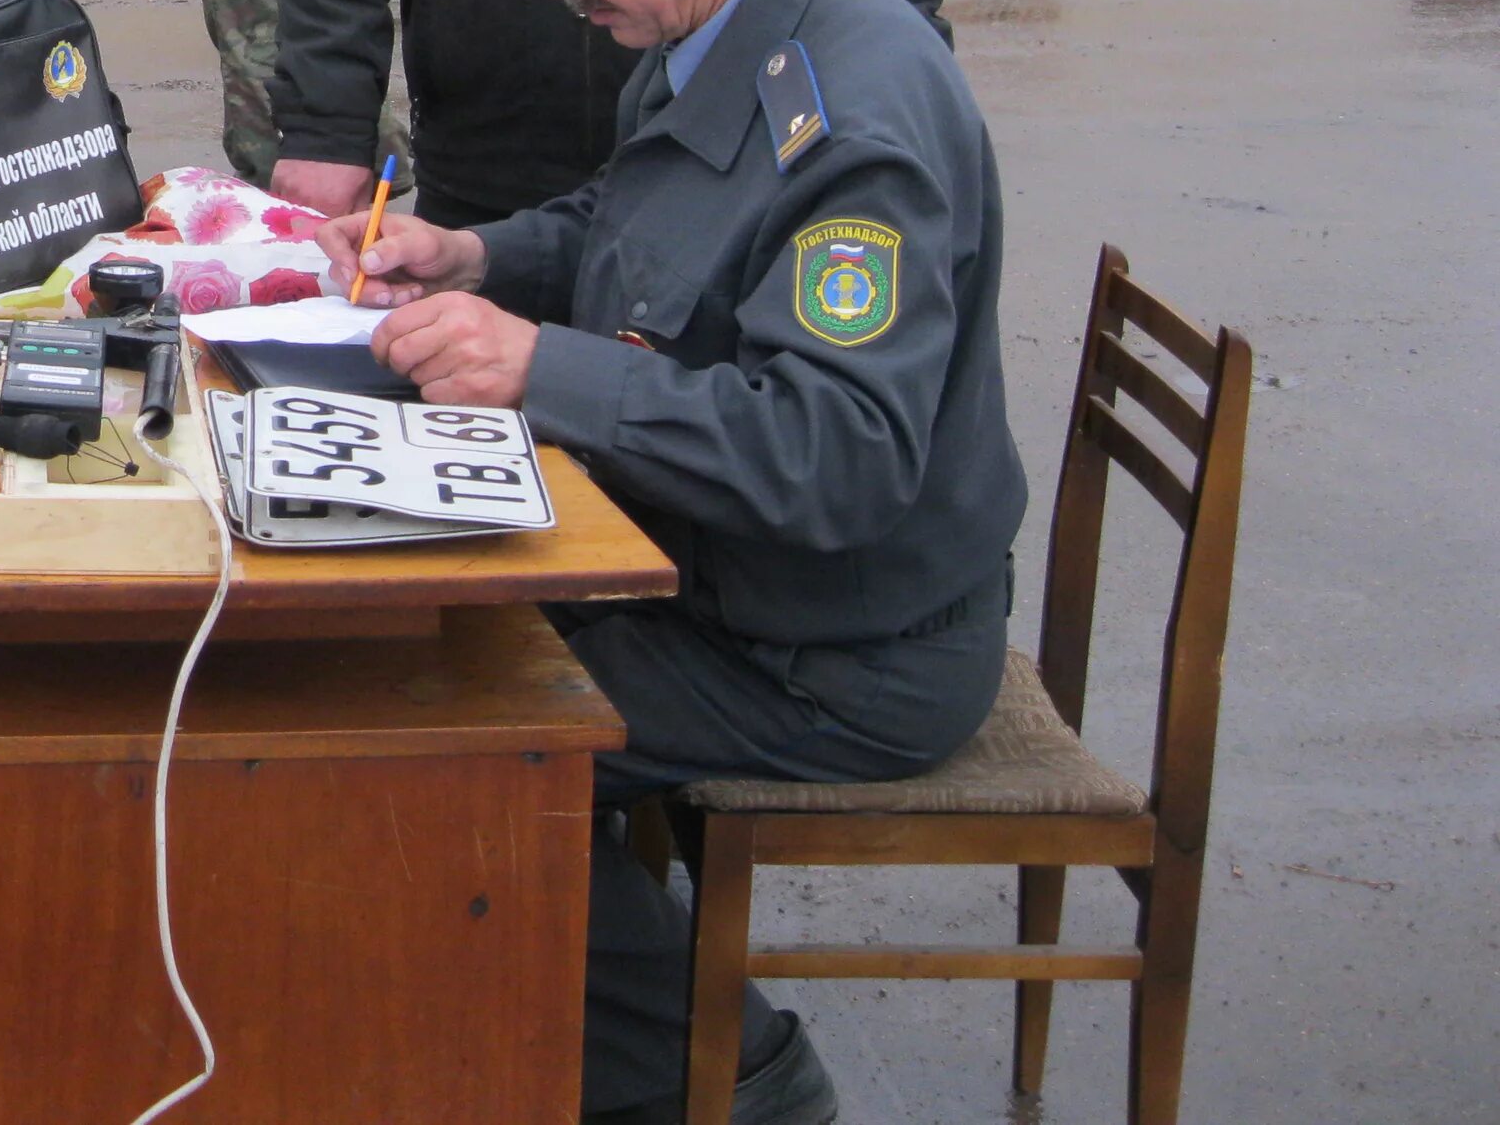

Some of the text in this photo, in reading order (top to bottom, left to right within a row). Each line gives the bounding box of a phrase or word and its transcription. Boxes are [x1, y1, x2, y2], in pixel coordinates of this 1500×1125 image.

[30, 191, 104, 239] области
[802, 226, 895, 251] ГОСТЕХНАДЗОР
[271, 397, 386, 486] 5459
[422, 410, 508, 443] 69
